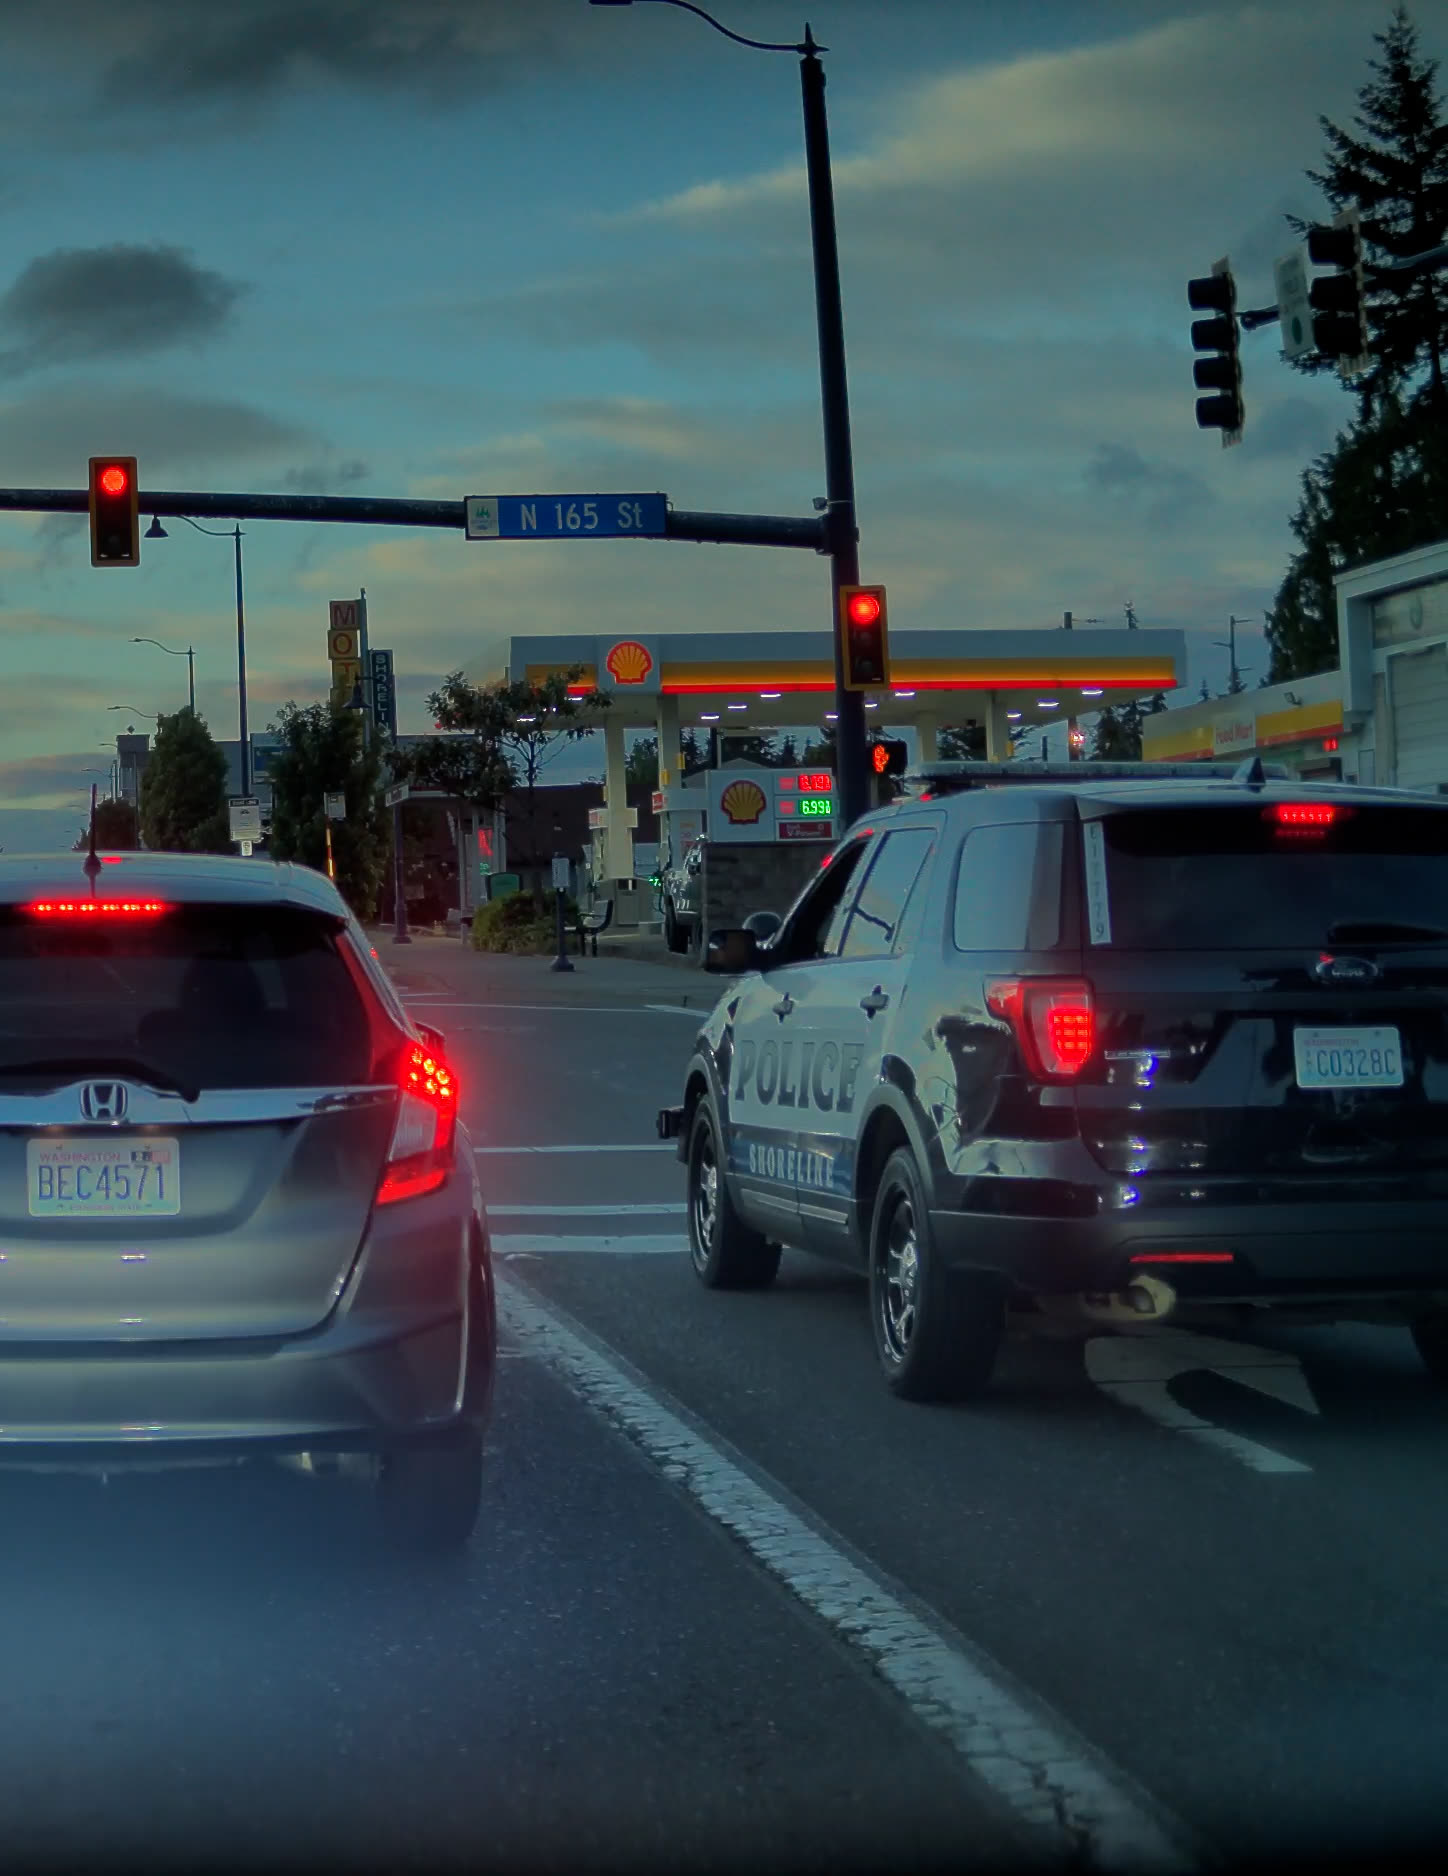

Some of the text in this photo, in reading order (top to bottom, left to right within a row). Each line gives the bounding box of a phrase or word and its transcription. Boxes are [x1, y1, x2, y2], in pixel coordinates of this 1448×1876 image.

[520, 501, 644, 531] N 165 St
[735, 1039, 865, 1114] POLICE
[40, 1152, 121, 1163] WASHINGTON
[749, 1143, 835, 1189] SHORELINE
[38, 1164, 164, 1200] BEC4571
